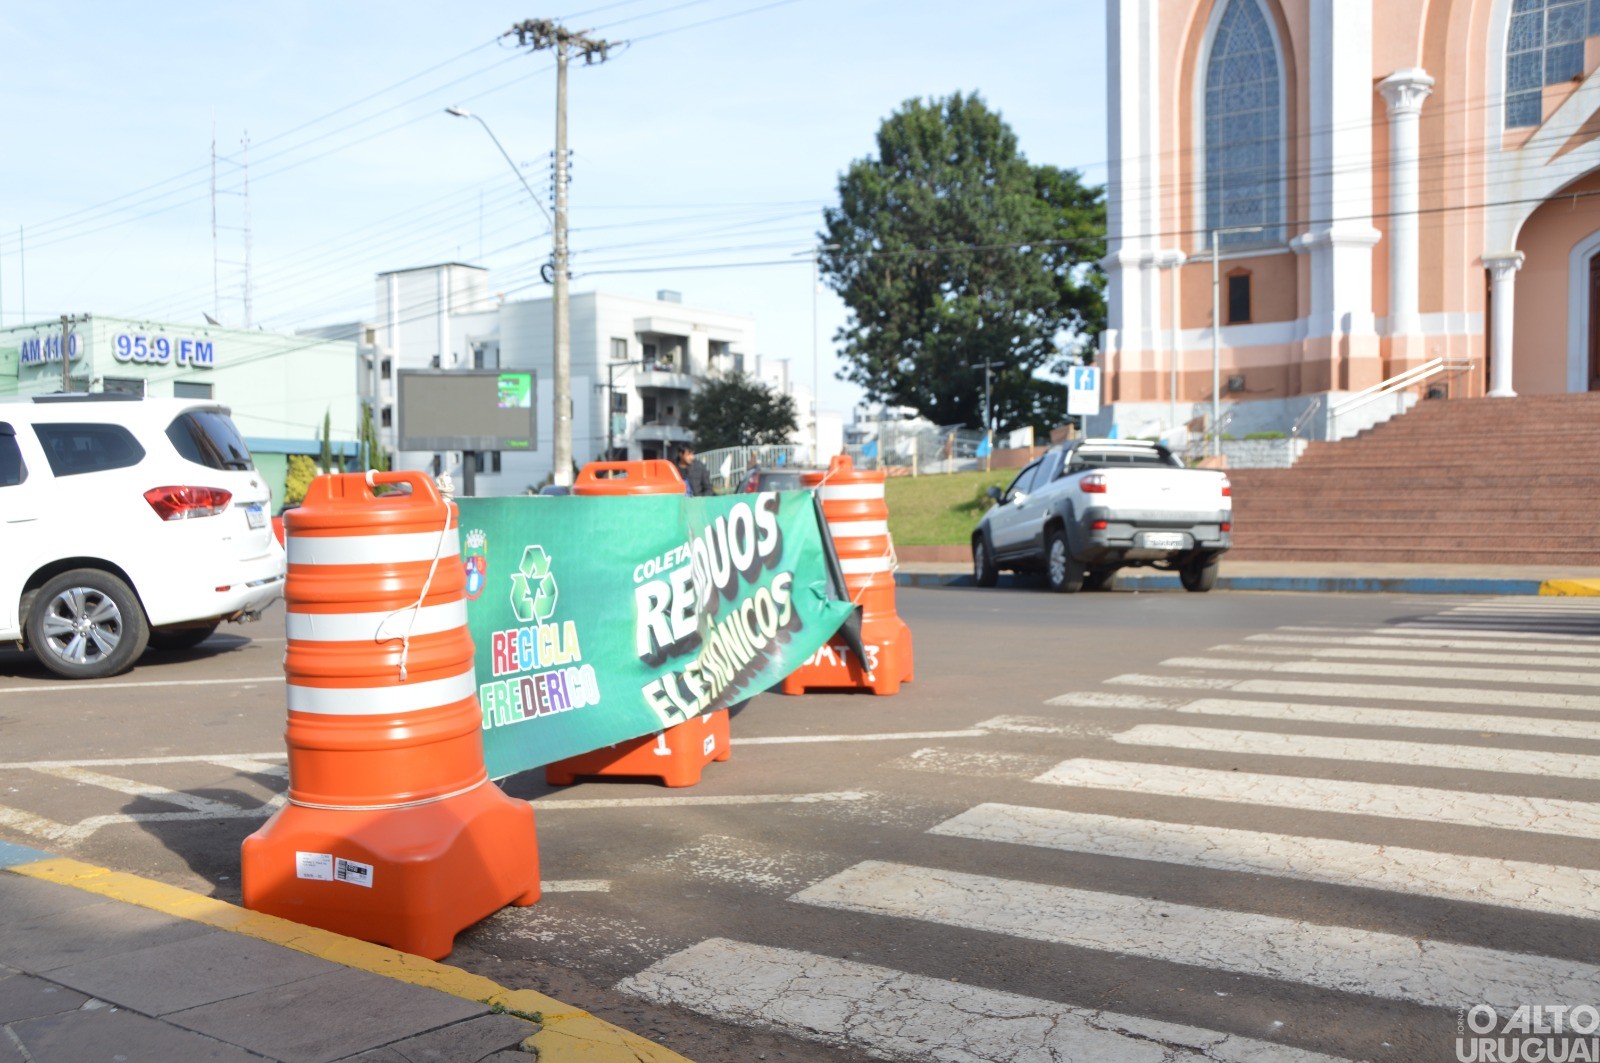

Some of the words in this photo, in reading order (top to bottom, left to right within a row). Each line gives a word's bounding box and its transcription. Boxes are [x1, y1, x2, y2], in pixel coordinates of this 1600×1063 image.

[21, 338, 41, 363] AM
[116, 333, 171, 360] 95.9
[179, 338, 214, 364] FM
[632, 541, 692, 584] COLETA
[634, 491, 779, 658] REDUOS
[491, 620, 582, 677] RECICLA
[480, 663, 601, 730] FREDERICO
